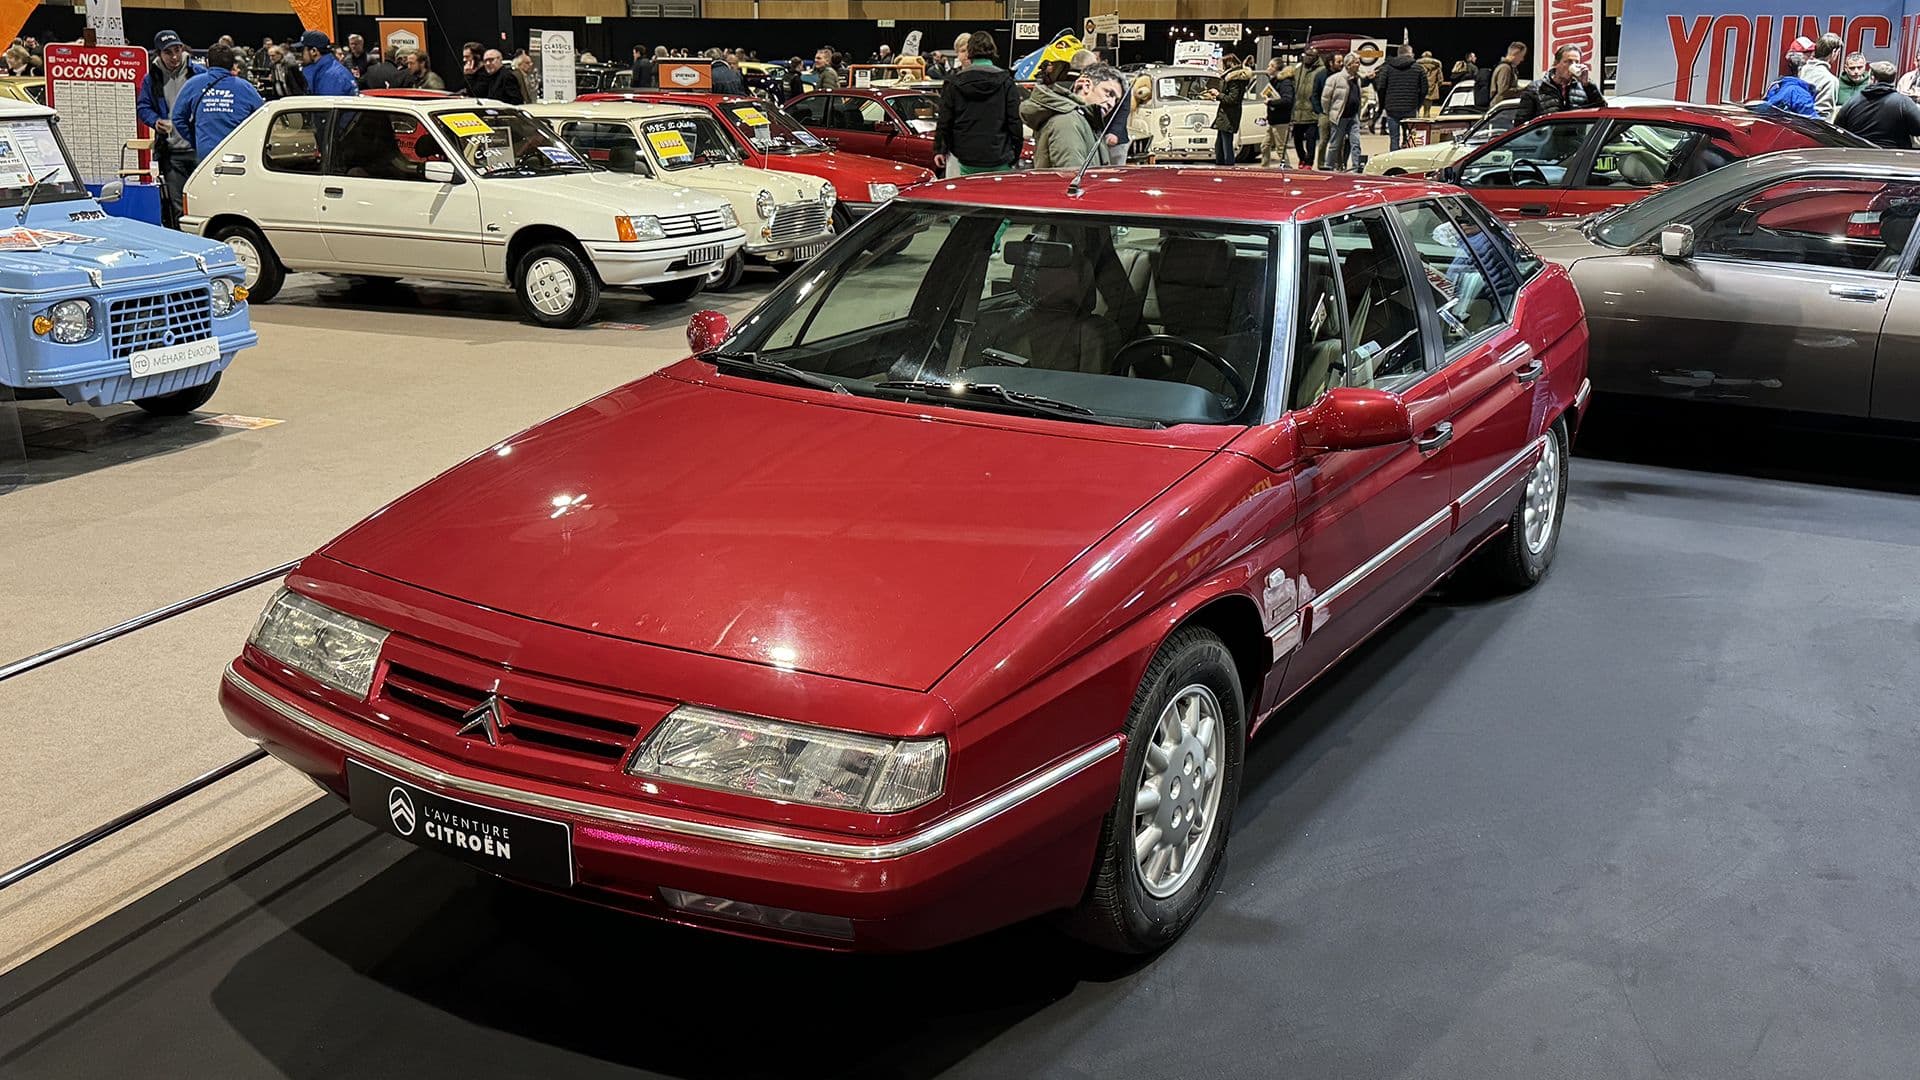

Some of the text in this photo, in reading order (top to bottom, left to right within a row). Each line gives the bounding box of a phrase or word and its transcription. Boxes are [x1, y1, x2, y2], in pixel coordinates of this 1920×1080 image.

[1019, 25, 1037, 35] FOOD
[1121, 25, 1140, 35] Court
[78, 53, 108, 66] NOS
[52, 65, 136, 80] OCCASIONS
[153, 351, 186, 366] MÉHARI
[187, 344, 216, 359] ÉVASION
[424, 806, 509, 839] L'AVENTURE
[425, 821, 511, 859] CITROËN
